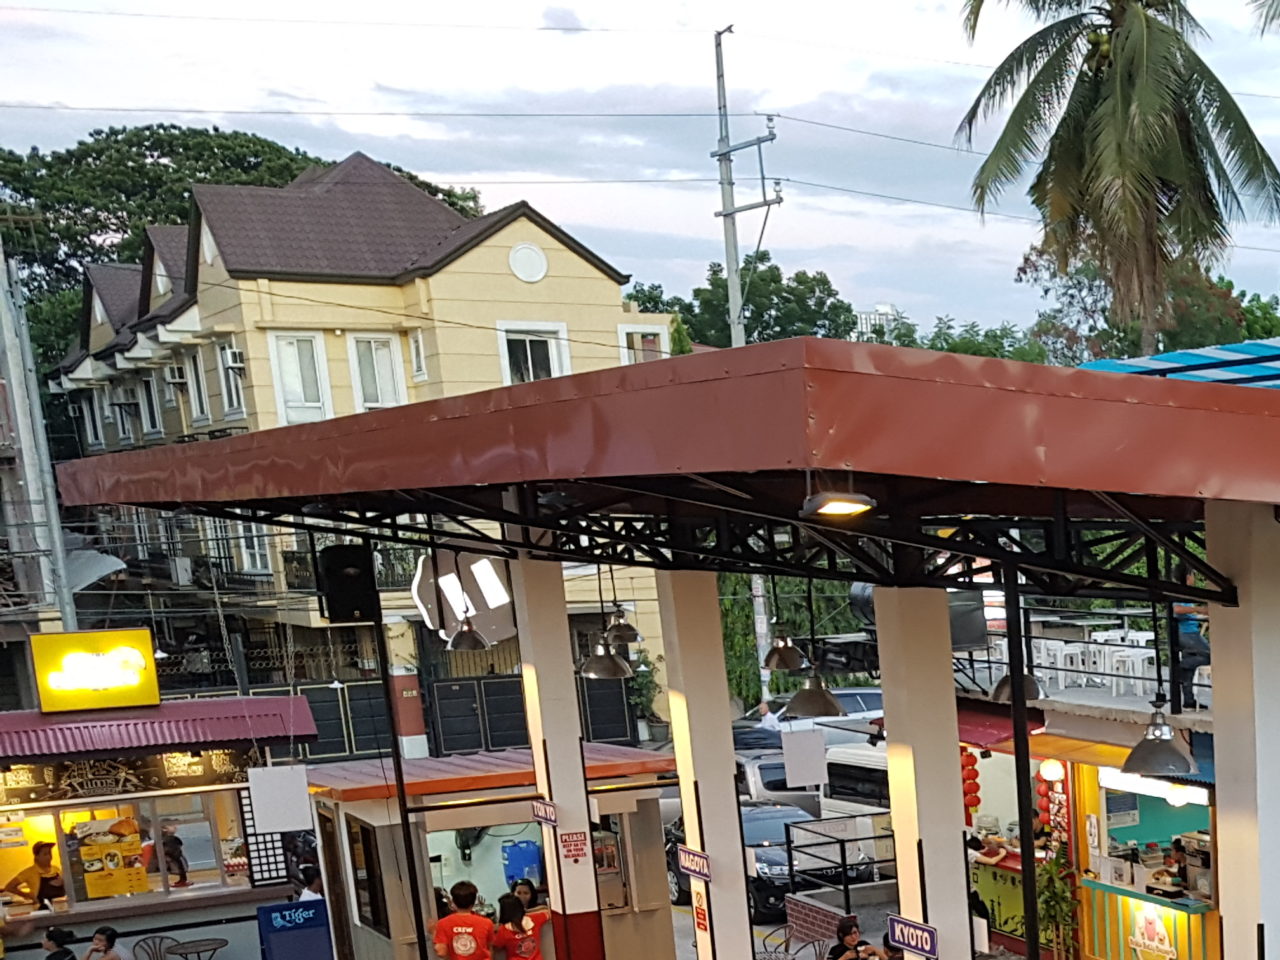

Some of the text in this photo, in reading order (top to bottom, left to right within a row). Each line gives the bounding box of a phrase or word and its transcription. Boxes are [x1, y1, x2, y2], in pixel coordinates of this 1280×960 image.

[532, 801, 556, 820] TOKYO
[562, 834, 585, 843] PLEASE
[680, 850, 709, 875] NAGOYA
[282, 907, 315, 924] Tiger
[894, 922, 931, 951] KYOTO
